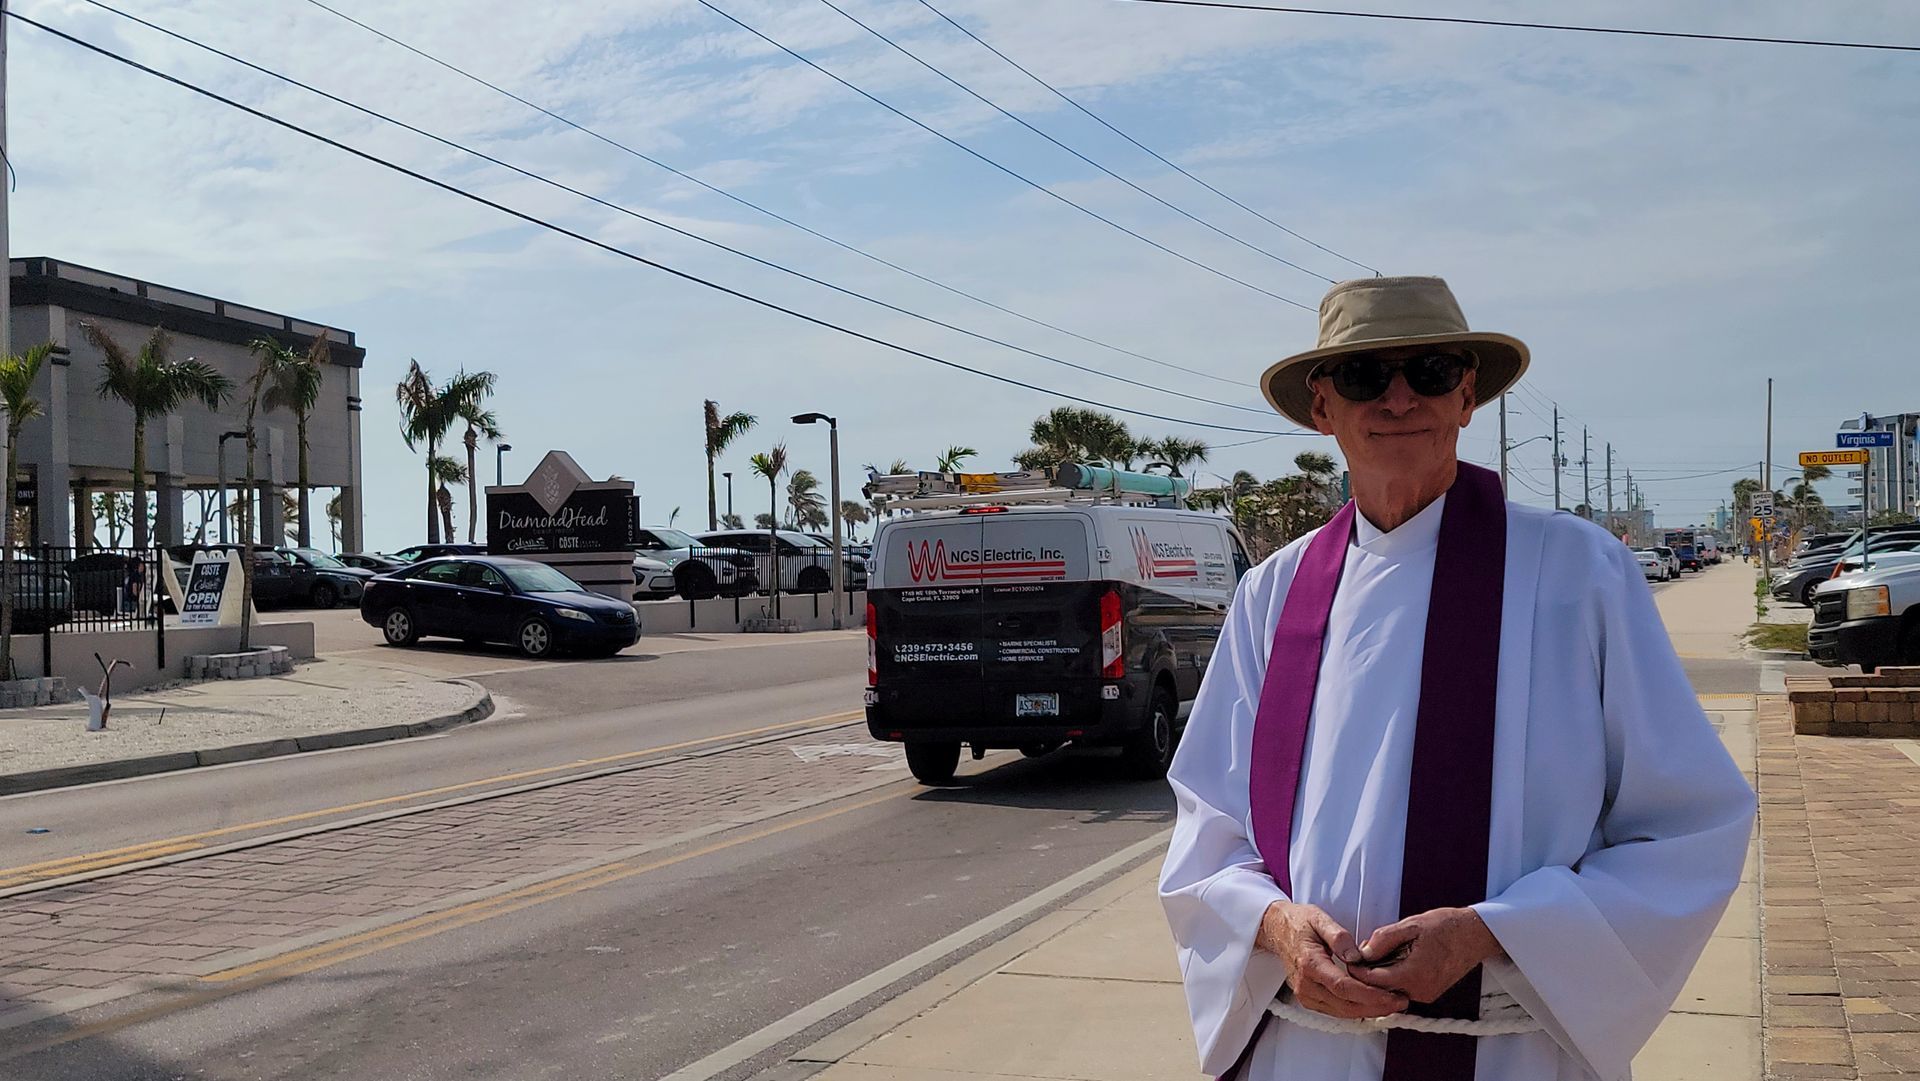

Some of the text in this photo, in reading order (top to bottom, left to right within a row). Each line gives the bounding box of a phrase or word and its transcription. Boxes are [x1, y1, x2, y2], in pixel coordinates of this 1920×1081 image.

[1840, 435, 1876, 447] Virginia
[1806, 453, 1853, 463] NO OUTLET
[17, 490, 35, 499] ONLY
[1753, 505, 1773, 516] 25
[499, 505, 608, 529] DiamondHead
[951, 547, 1064, 563] NCS Electric, Inc.
[1151, 543, 1165, 557] NCS
[188, 592, 220, 604] OPEN
